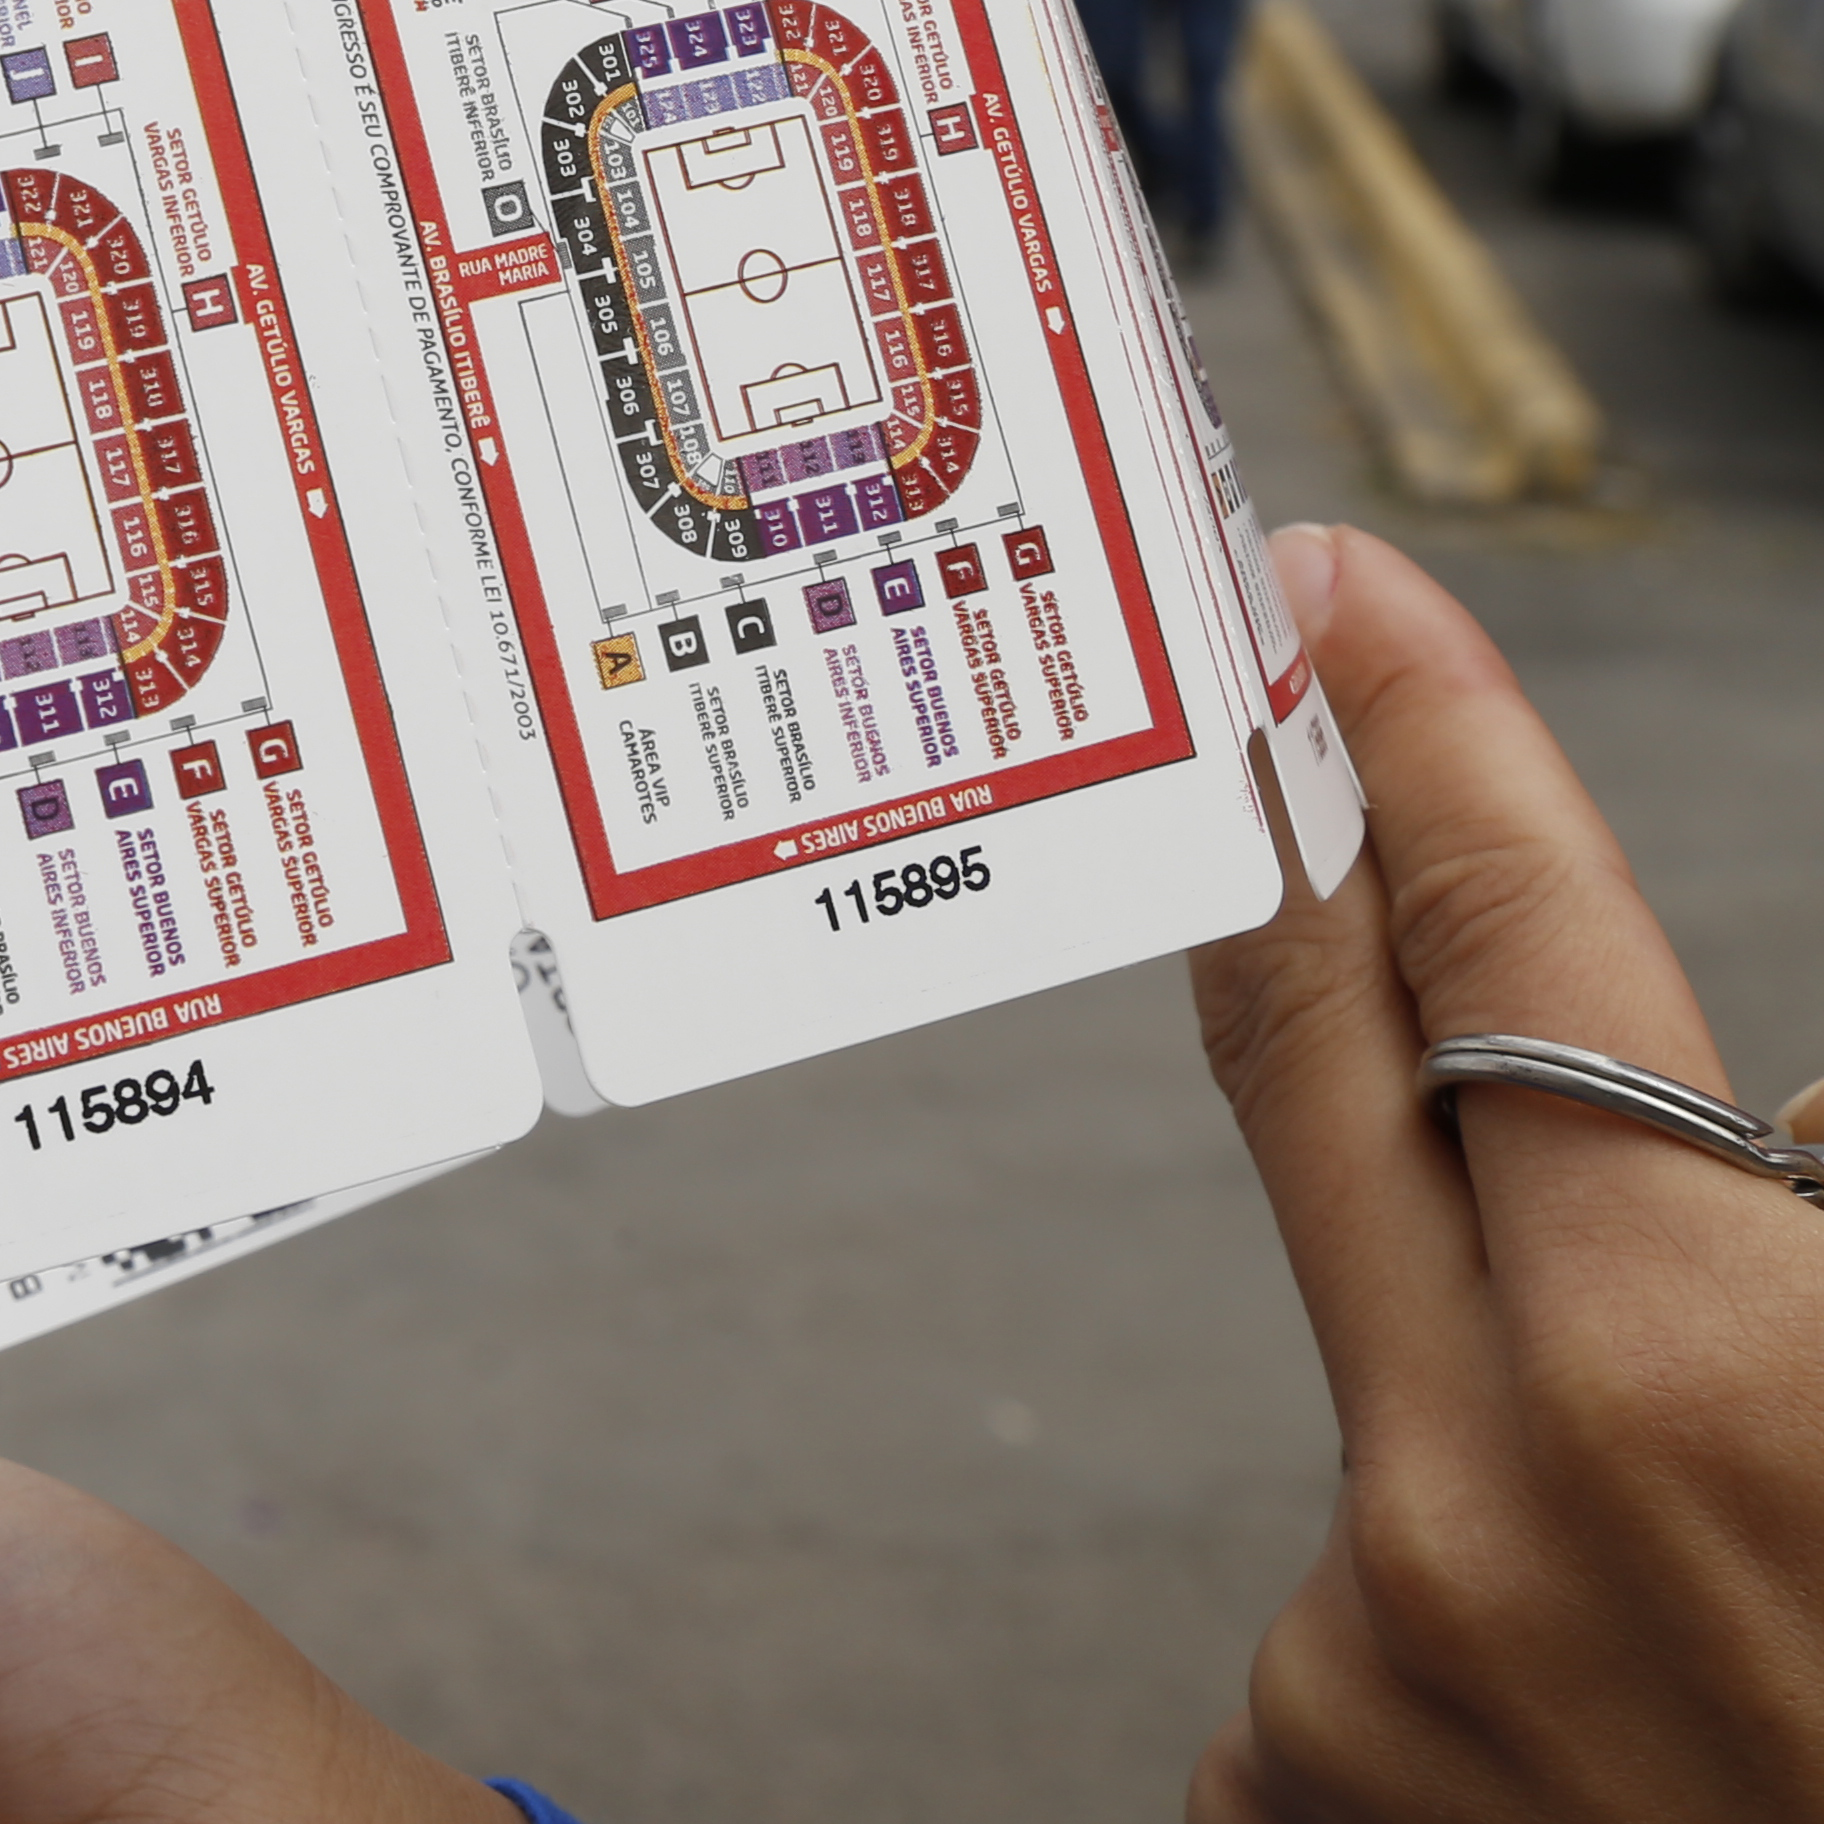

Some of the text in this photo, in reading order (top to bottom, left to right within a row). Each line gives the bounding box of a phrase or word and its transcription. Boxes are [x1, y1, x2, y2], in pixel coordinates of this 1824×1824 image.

[830, 133, 854, 172] 119
[848, 198, 872, 237] 118
[981, 90, 1052, 293] AV. GETÚLIO VARGAS
[190, 288, 224, 318] H
[866, 263, 890, 303] 117
[420, 217, 493, 428] AV. BRASÍLIO ITIBERÊ
[244, 260, 315, 475] AV. GETÚLIO VARGAS
[35, 692, 60, 733] 311
[91, 678, 117, 719] 312
[257, 736, 288, 763] G
[754, 664, 801, 803] ITIBERÊ SUPERIOR
[772, 669, 817, 792] SETOR BRASÍLIO
[106, 775, 138, 801] E
[180, 758, 211, 783] F
[801, 783, 993, 853] RUA BUENOS AIRES
[811, 845, 992, 934] 115895
[2, 992, 222, 1069] RUA BUENOS AIRES
[11, 1058, 217, 1153] 115894
